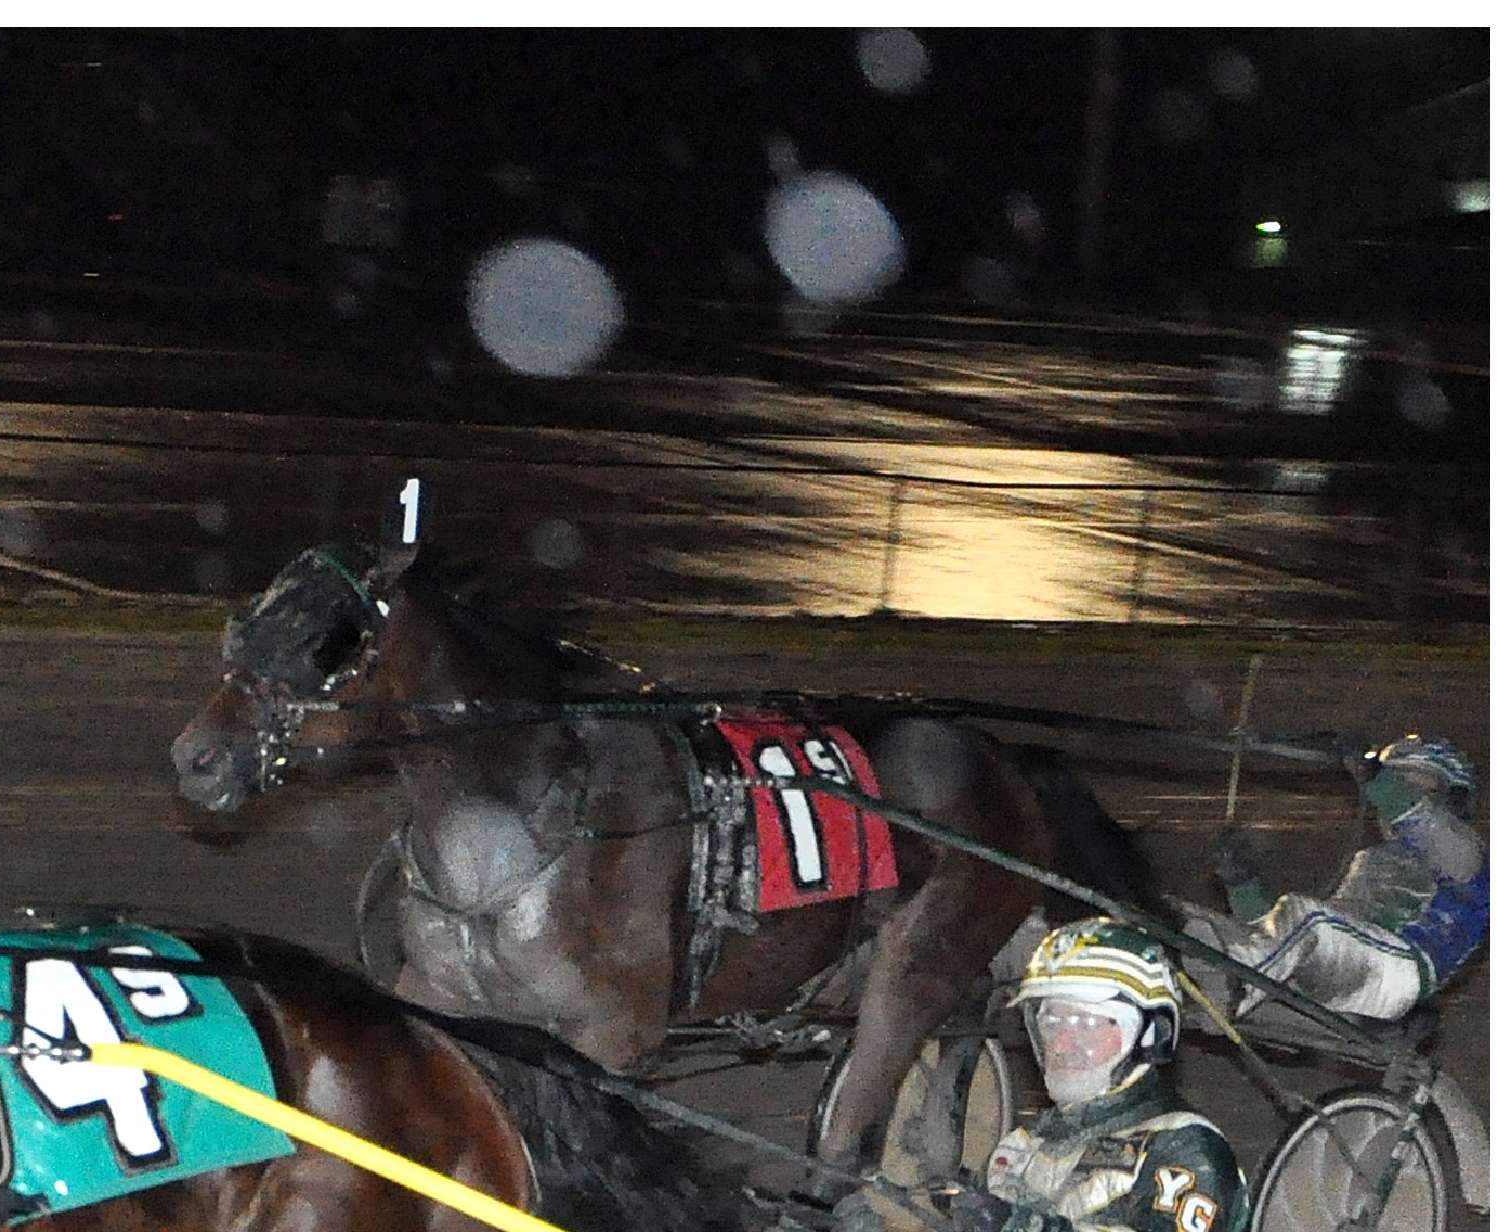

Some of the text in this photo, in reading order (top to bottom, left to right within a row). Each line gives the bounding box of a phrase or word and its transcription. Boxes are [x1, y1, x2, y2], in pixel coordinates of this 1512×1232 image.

[399, 477, 420, 544] 1
[758, 744, 824, 884] 1
[19, 956, 164, 1160] 4
